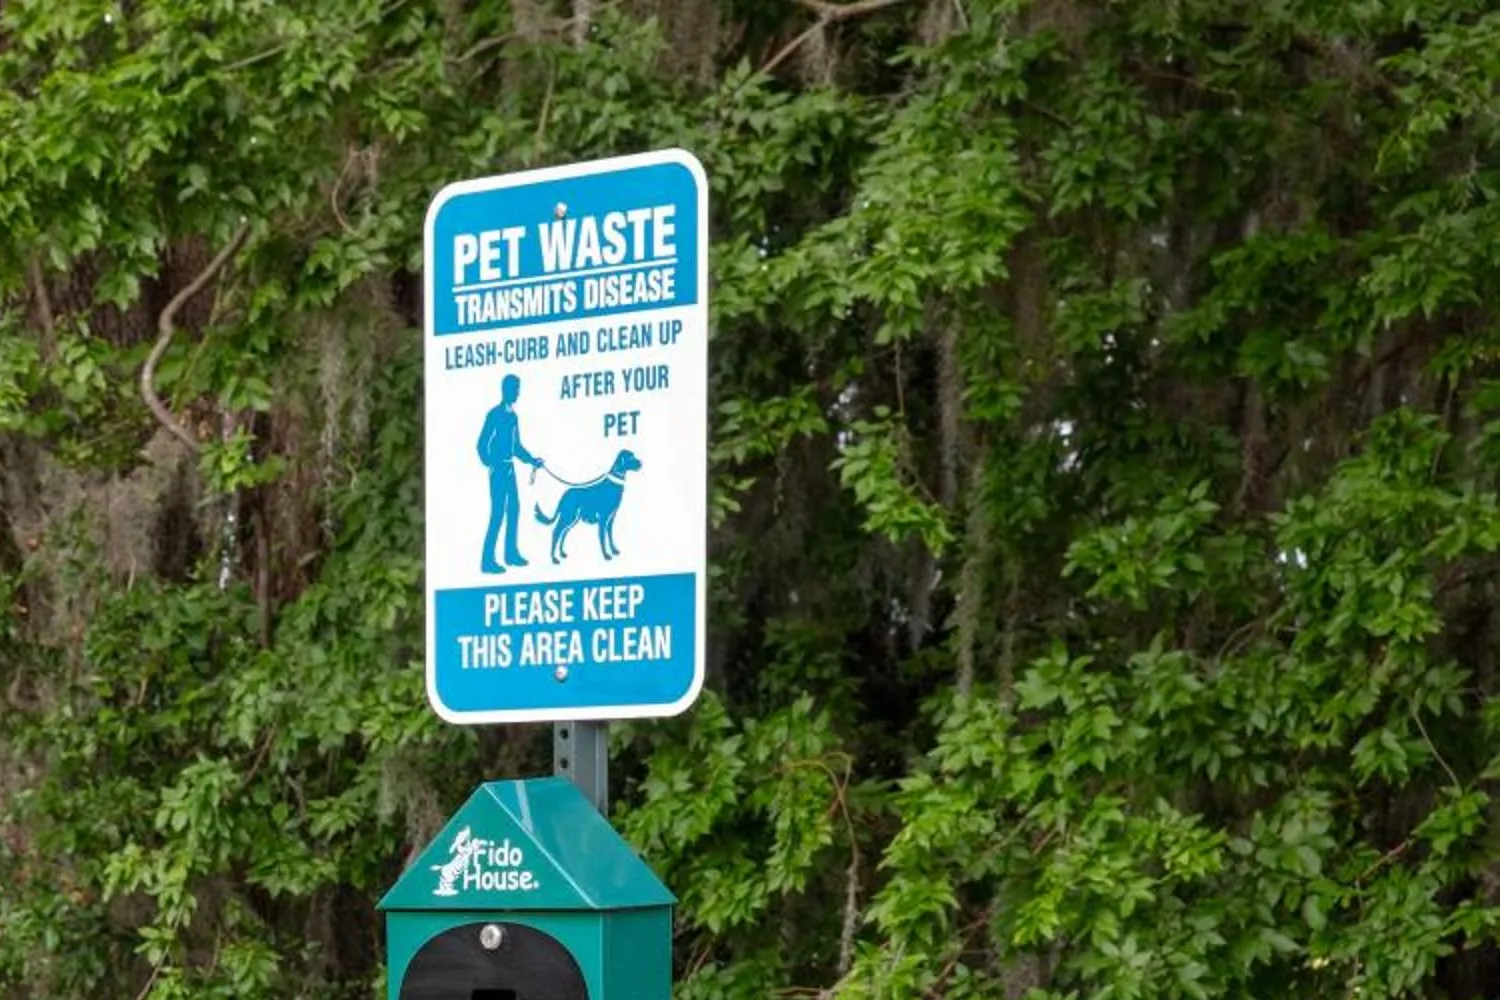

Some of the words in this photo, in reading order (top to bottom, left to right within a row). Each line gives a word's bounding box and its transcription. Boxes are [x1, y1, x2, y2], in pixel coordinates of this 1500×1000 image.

[453, 226, 526, 285] PET
[538, 204, 677, 273] WASTE
[455, 280, 577, 325] TRANSMITS
[584, 267, 675, 311] DISEASE
[445, 335, 549, 370] LEASH-CURB
[555, 331, 591, 359] AND
[597, 323, 652, 352] CLEAN
[659, 319, 683, 345] UP
[560, 370, 615, 399] AFTER
[622, 364, 669, 392] YOUR
[604, 411, 640, 437] PET
[484, 589, 574, 627] PLEASE
[582, 584, 644, 621] KEEP
[457, 634, 512, 669] THIS
[519, 630, 584, 666] AREA
[591, 625, 672, 662] CLEAN
[472, 838, 523, 866] Fido
